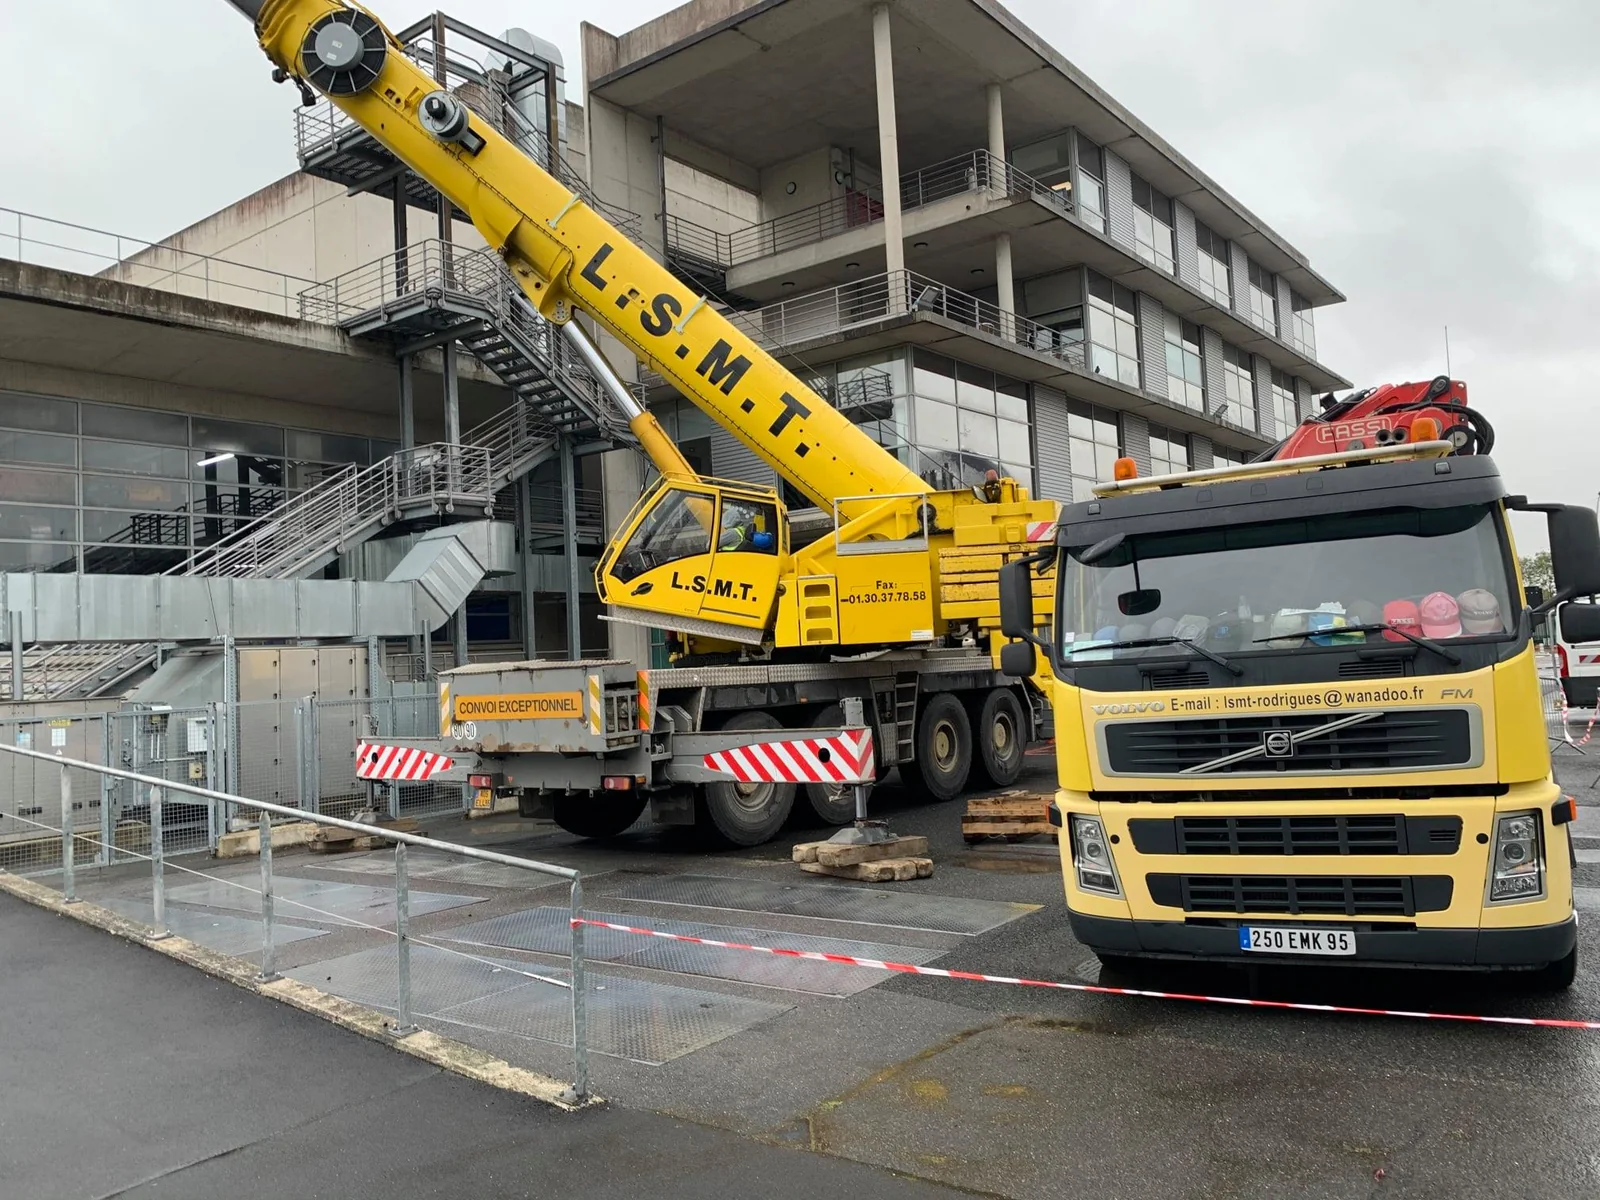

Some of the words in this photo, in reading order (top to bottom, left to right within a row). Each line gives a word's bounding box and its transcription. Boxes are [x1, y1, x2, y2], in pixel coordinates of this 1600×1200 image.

[1320, 419, 1386, 441] FASSI
[671, 571, 757, 602] L.S.M.T.
[875, 580, 898, 590] Fax:
[1170, 696, 1212, 711] E-mail
[1223, 686, 1425, 709] lsmt-rodrigues@wanadoo.fr
[1440, 688, 1474, 700] FM
[459, 701, 497, 714] CONVOI
[498, 698, 578, 713] EXCEPTIONNEL
[1091, 700, 1165, 715] VOLVO
[1252, 930, 1284, 949] 250
[1288, 931, 1322, 950] EMK
[1327, 933, 1348, 951] 95
